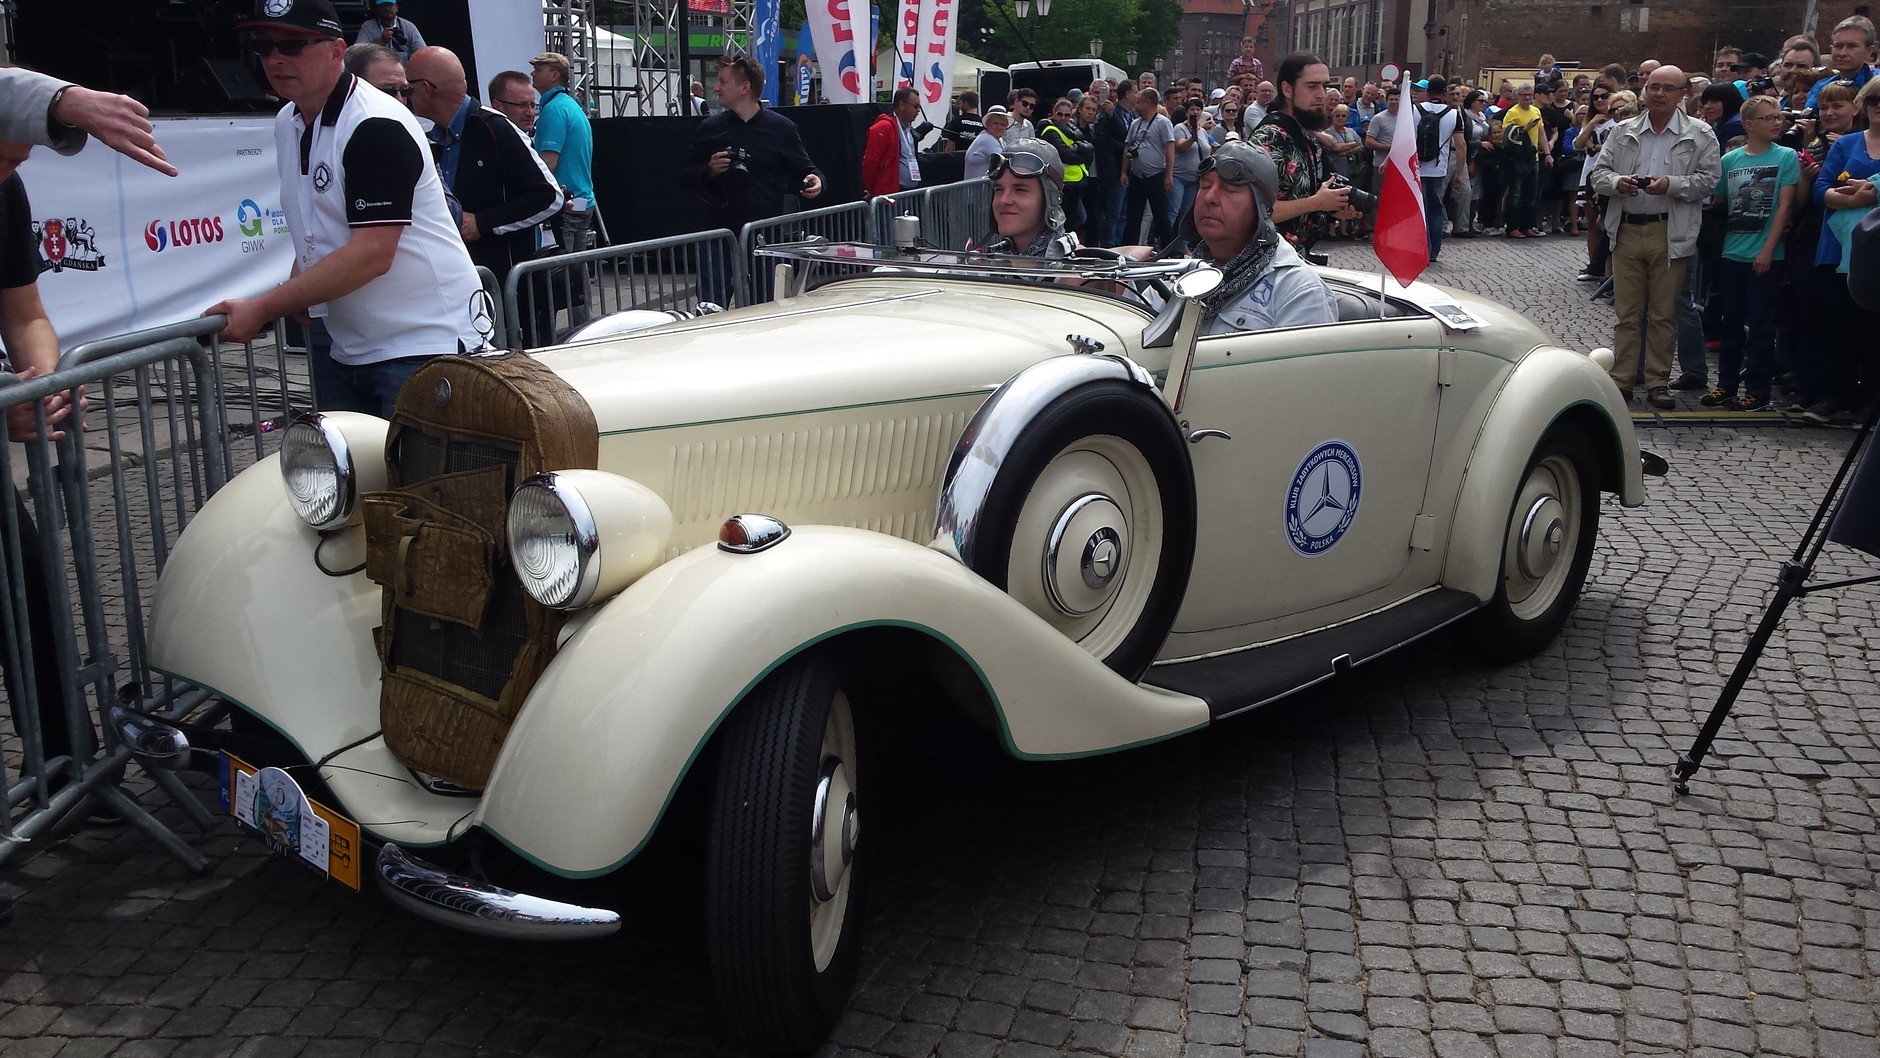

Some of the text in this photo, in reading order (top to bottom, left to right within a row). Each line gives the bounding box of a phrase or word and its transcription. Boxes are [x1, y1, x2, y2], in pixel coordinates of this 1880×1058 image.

[169, 215, 224, 247] LOTOS
[241, 239, 265, 253] GIWK
[1289, 448, 1359, 509] KLUB ZABYTKOWYCH MERCEDESÓW
[1309, 535, 1334, 550] POLSKA
